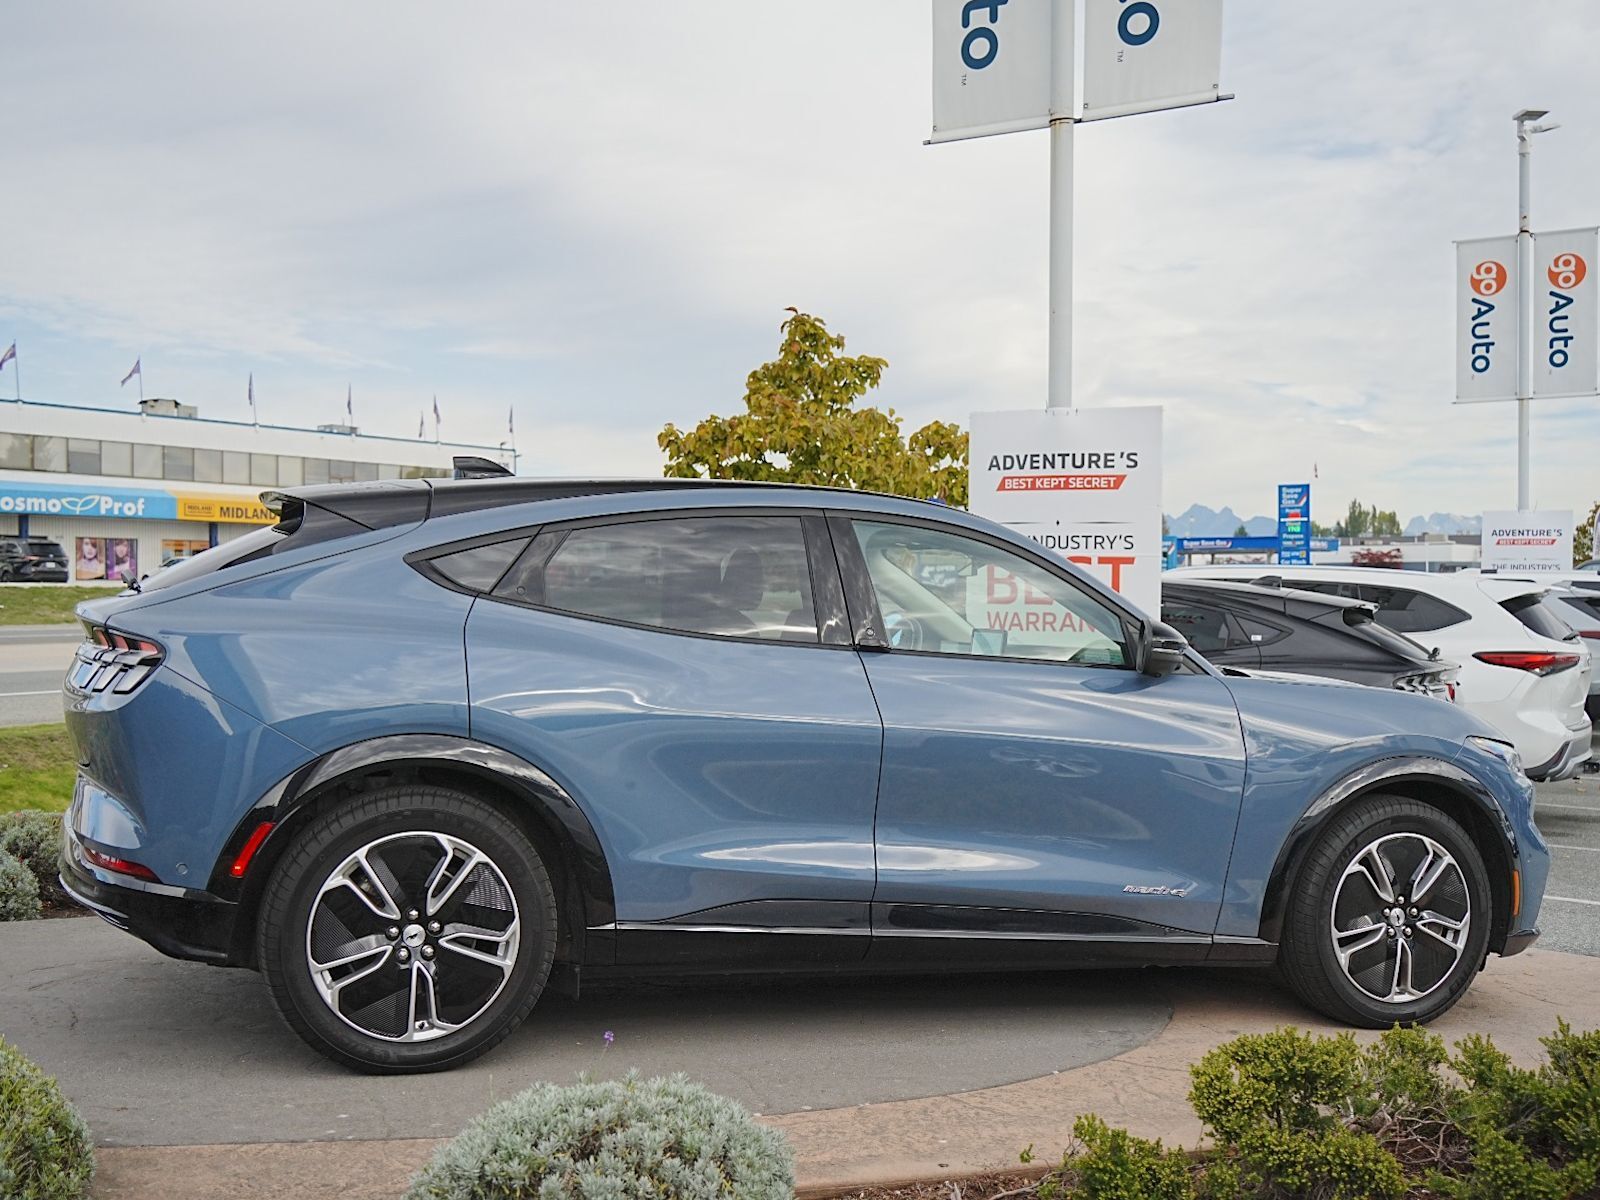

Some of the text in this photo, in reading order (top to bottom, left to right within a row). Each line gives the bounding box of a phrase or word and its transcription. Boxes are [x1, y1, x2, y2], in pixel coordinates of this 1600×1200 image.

[1471, 297, 1495, 373] Auto
[1549, 290, 1574, 368] Auto
[988, 452, 1138, 471] ADVENTURE'S
[1004, 477, 1117, 489] BEST KEPT SECRET
[100, 496, 145, 516] Prof
[1491, 528, 1563, 537] ADVENTURE'S
[1027, 535, 1134, 550] NDUSTRY'S
[1510, 563, 1560, 571] INDUSTRY'S
